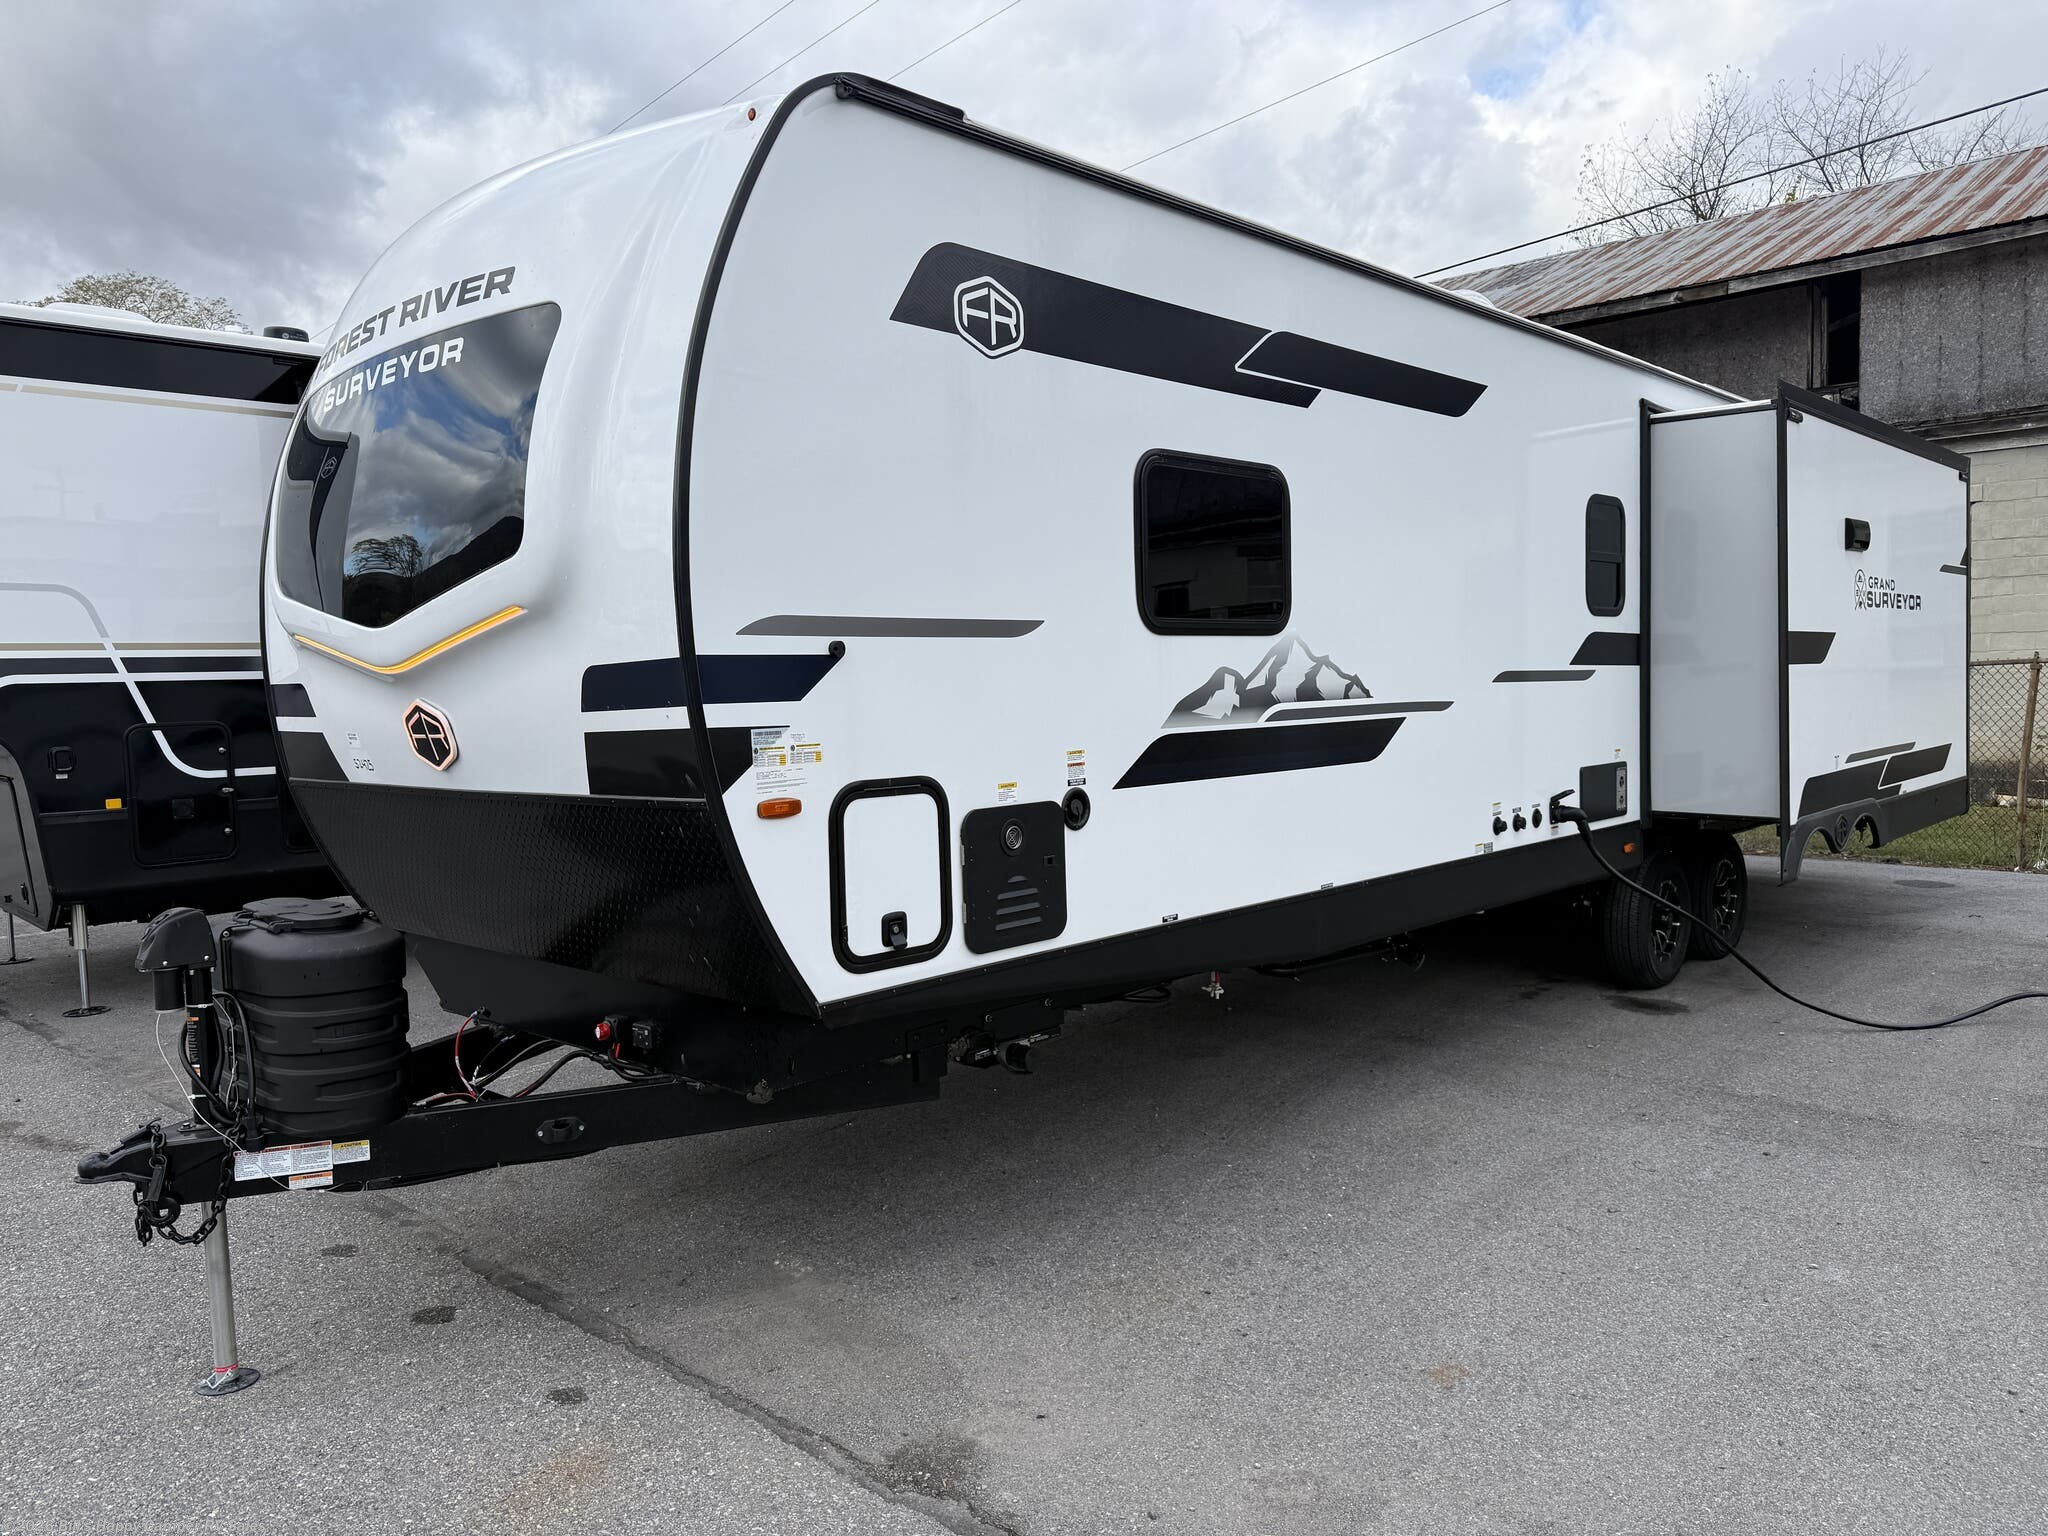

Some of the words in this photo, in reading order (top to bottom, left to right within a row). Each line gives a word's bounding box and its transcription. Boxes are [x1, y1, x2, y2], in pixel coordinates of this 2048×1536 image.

[316, 305, 396, 380] FOREST
[399, 266, 516, 328] RIVER
[324, 337, 465, 413] SURVEYOR
[1866, 590, 1922, 610] SURVEYOR
[1868, 575, 1896, 591] GRAND
